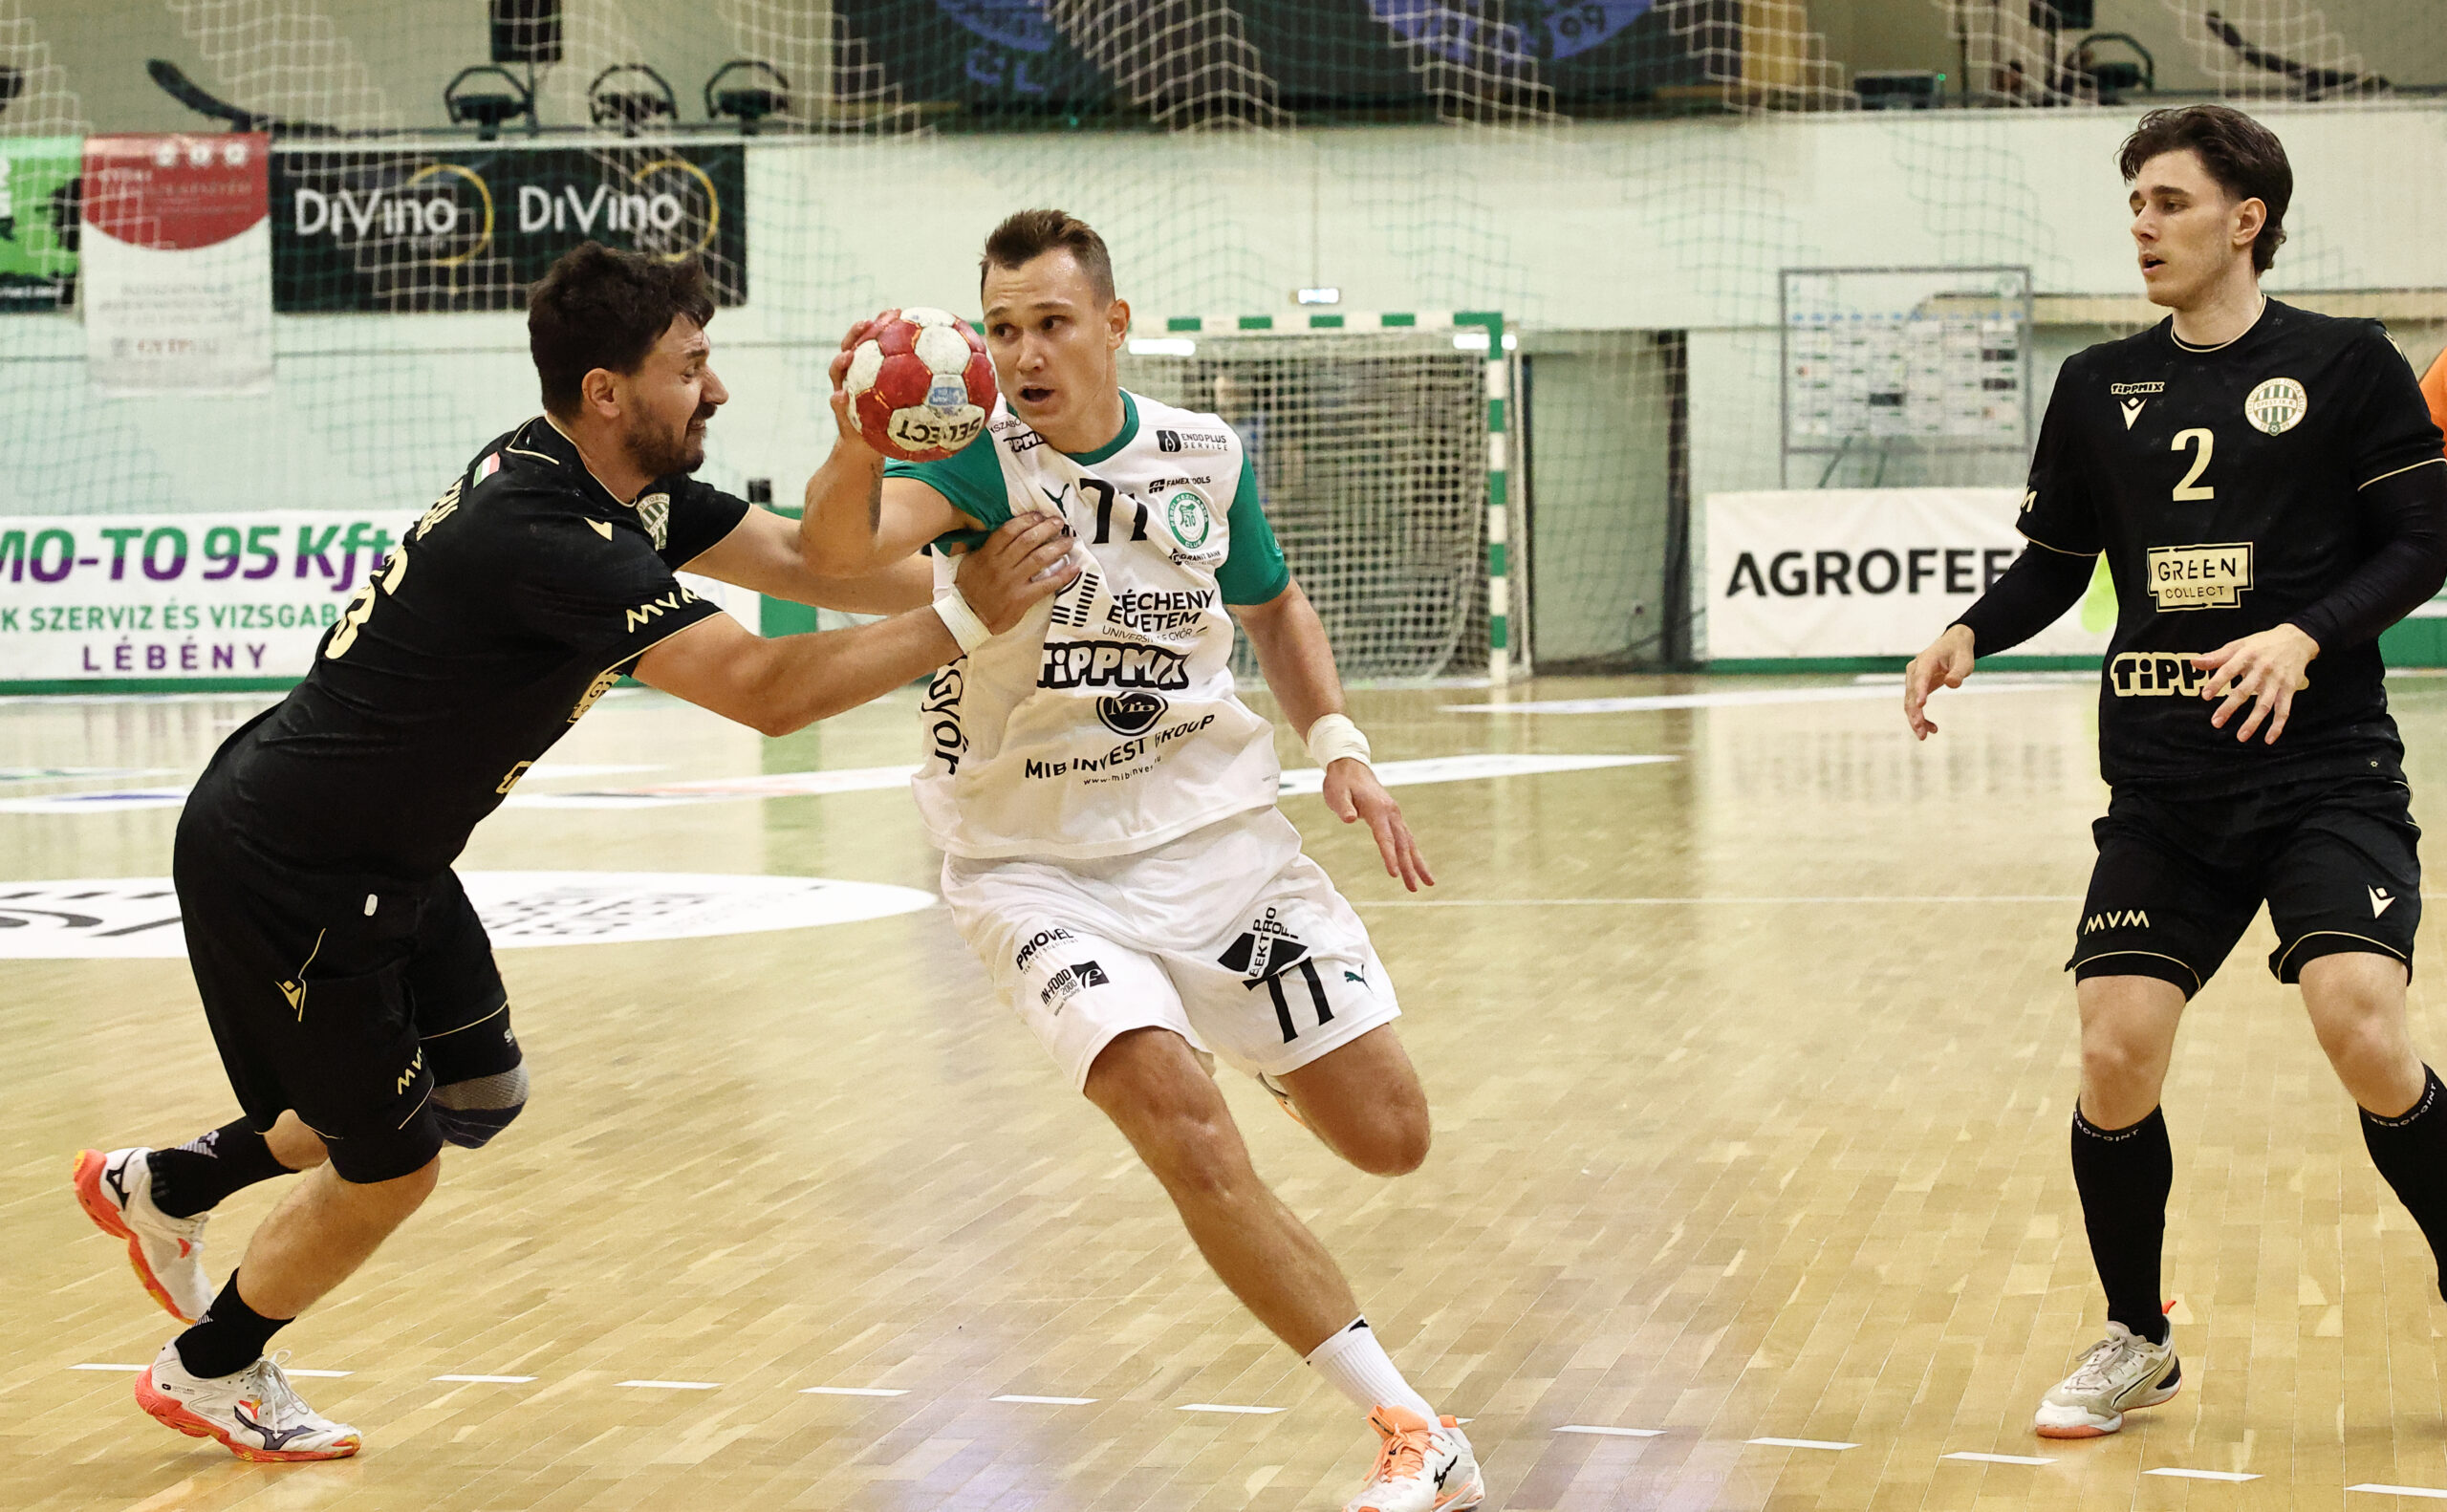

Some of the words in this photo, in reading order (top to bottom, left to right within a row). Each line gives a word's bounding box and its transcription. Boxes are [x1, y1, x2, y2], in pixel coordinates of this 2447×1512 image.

[295, 187, 458, 236] DiVino
[519, 184, 683, 234] DiVino
[2171, 428, 2215, 502] 2
[204, 526, 280, 580] 95
[294, 522, 396, 593] Kft
[1726, 548, 2019, 597] AGROFEE
[2157, 556, 2237, 581] GREEN
[2165, 585, 2225, 599] COLLECT
[30, 604, 153, 632] SZERVIZ
[164, 598, 200, 629] ÉS
[84, 637, 267, 671] LÉBÉNY
[2111, 652, 2244, 697] TiPP
[1025, 758, 1067, 779] MIB
[1072, 737, 1147, 771] INVEST
[2085, 910, 2150, 936] MVM
[1016, 928, 1074, 970] PRIOVEL
[1041, 968, 1072, 1005] IN-FOOD
[1061, 979, 1077, 995] 2000
[1242, 956, 1335, 1044] 77
[398, 1046, 422, 1095] MV
